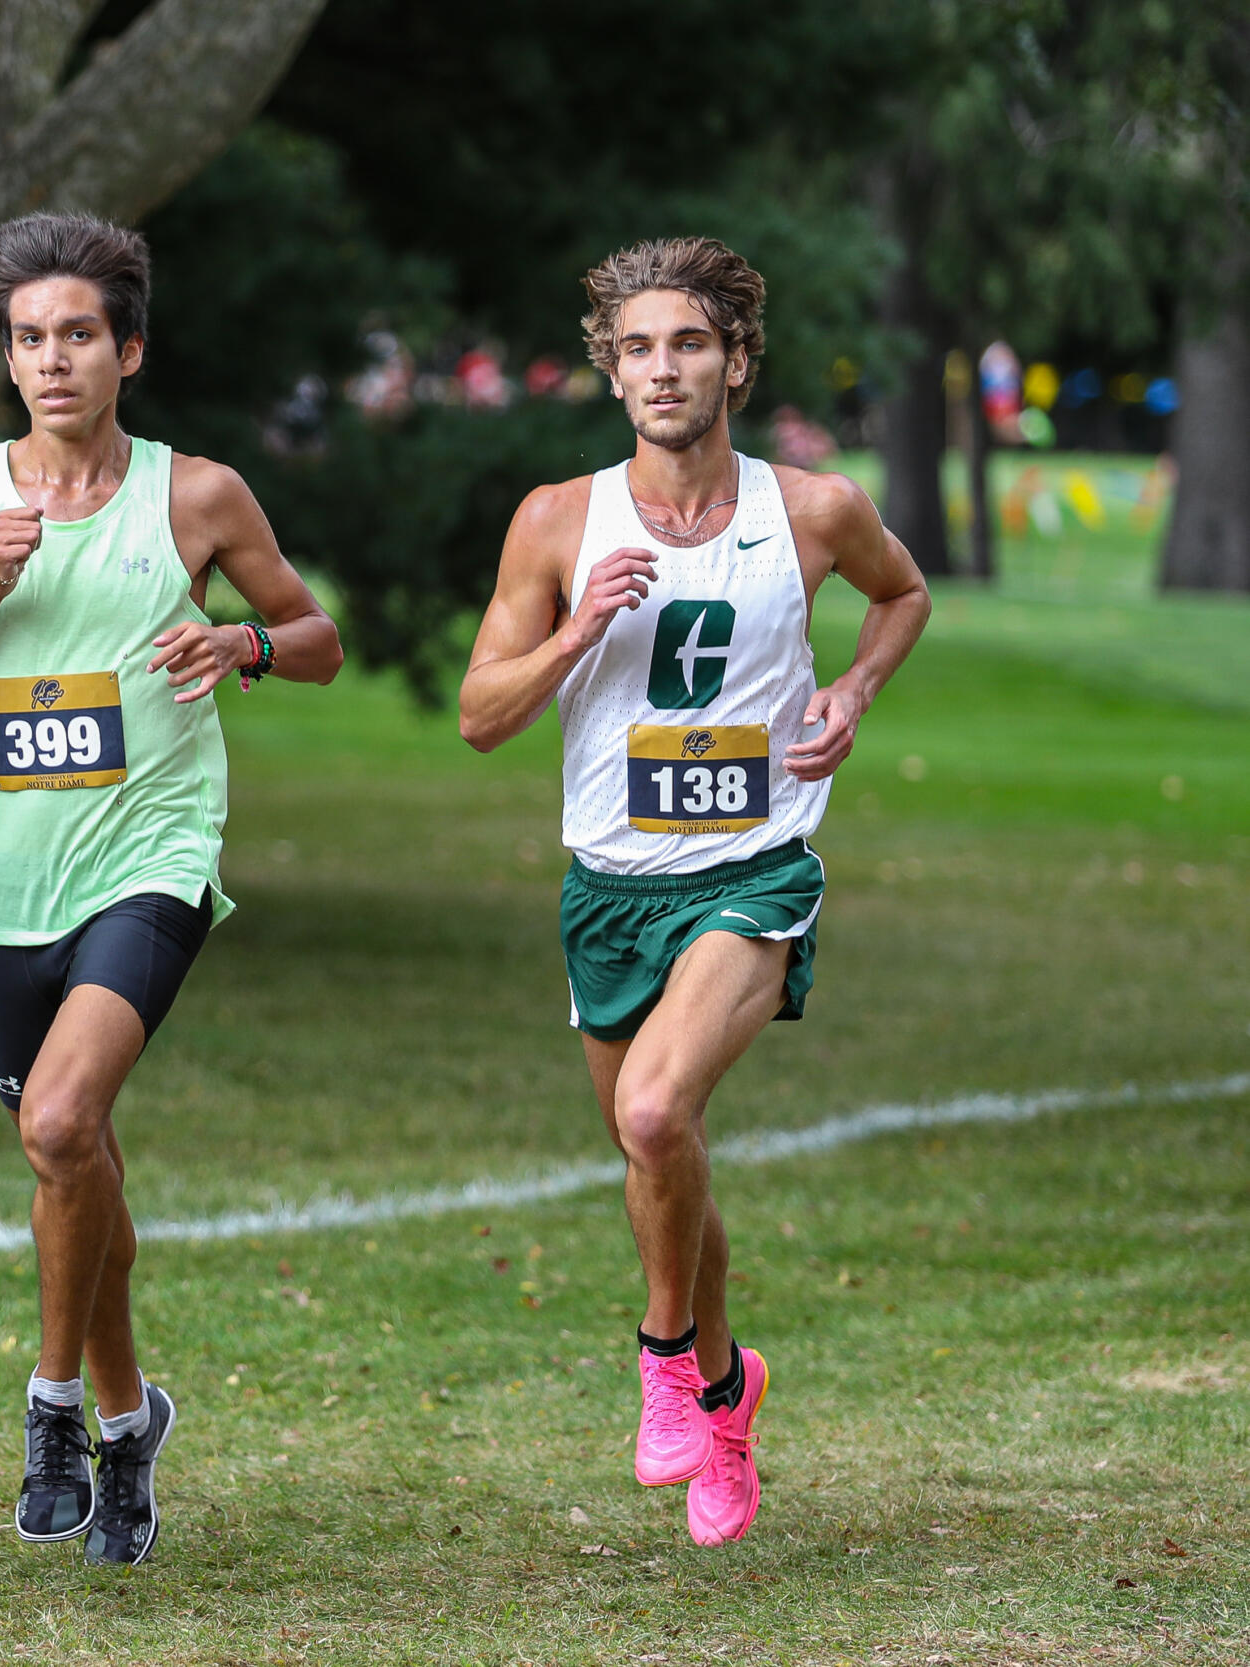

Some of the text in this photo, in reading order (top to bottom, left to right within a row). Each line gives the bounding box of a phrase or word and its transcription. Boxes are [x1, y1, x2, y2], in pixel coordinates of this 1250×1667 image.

[5, 715, 102, 769] 399
[26, 778, 87, 790] NOTRE DAME
[651, 765, 748, 814] 138
[667, 825, 731, 834] NOTRE DAME
